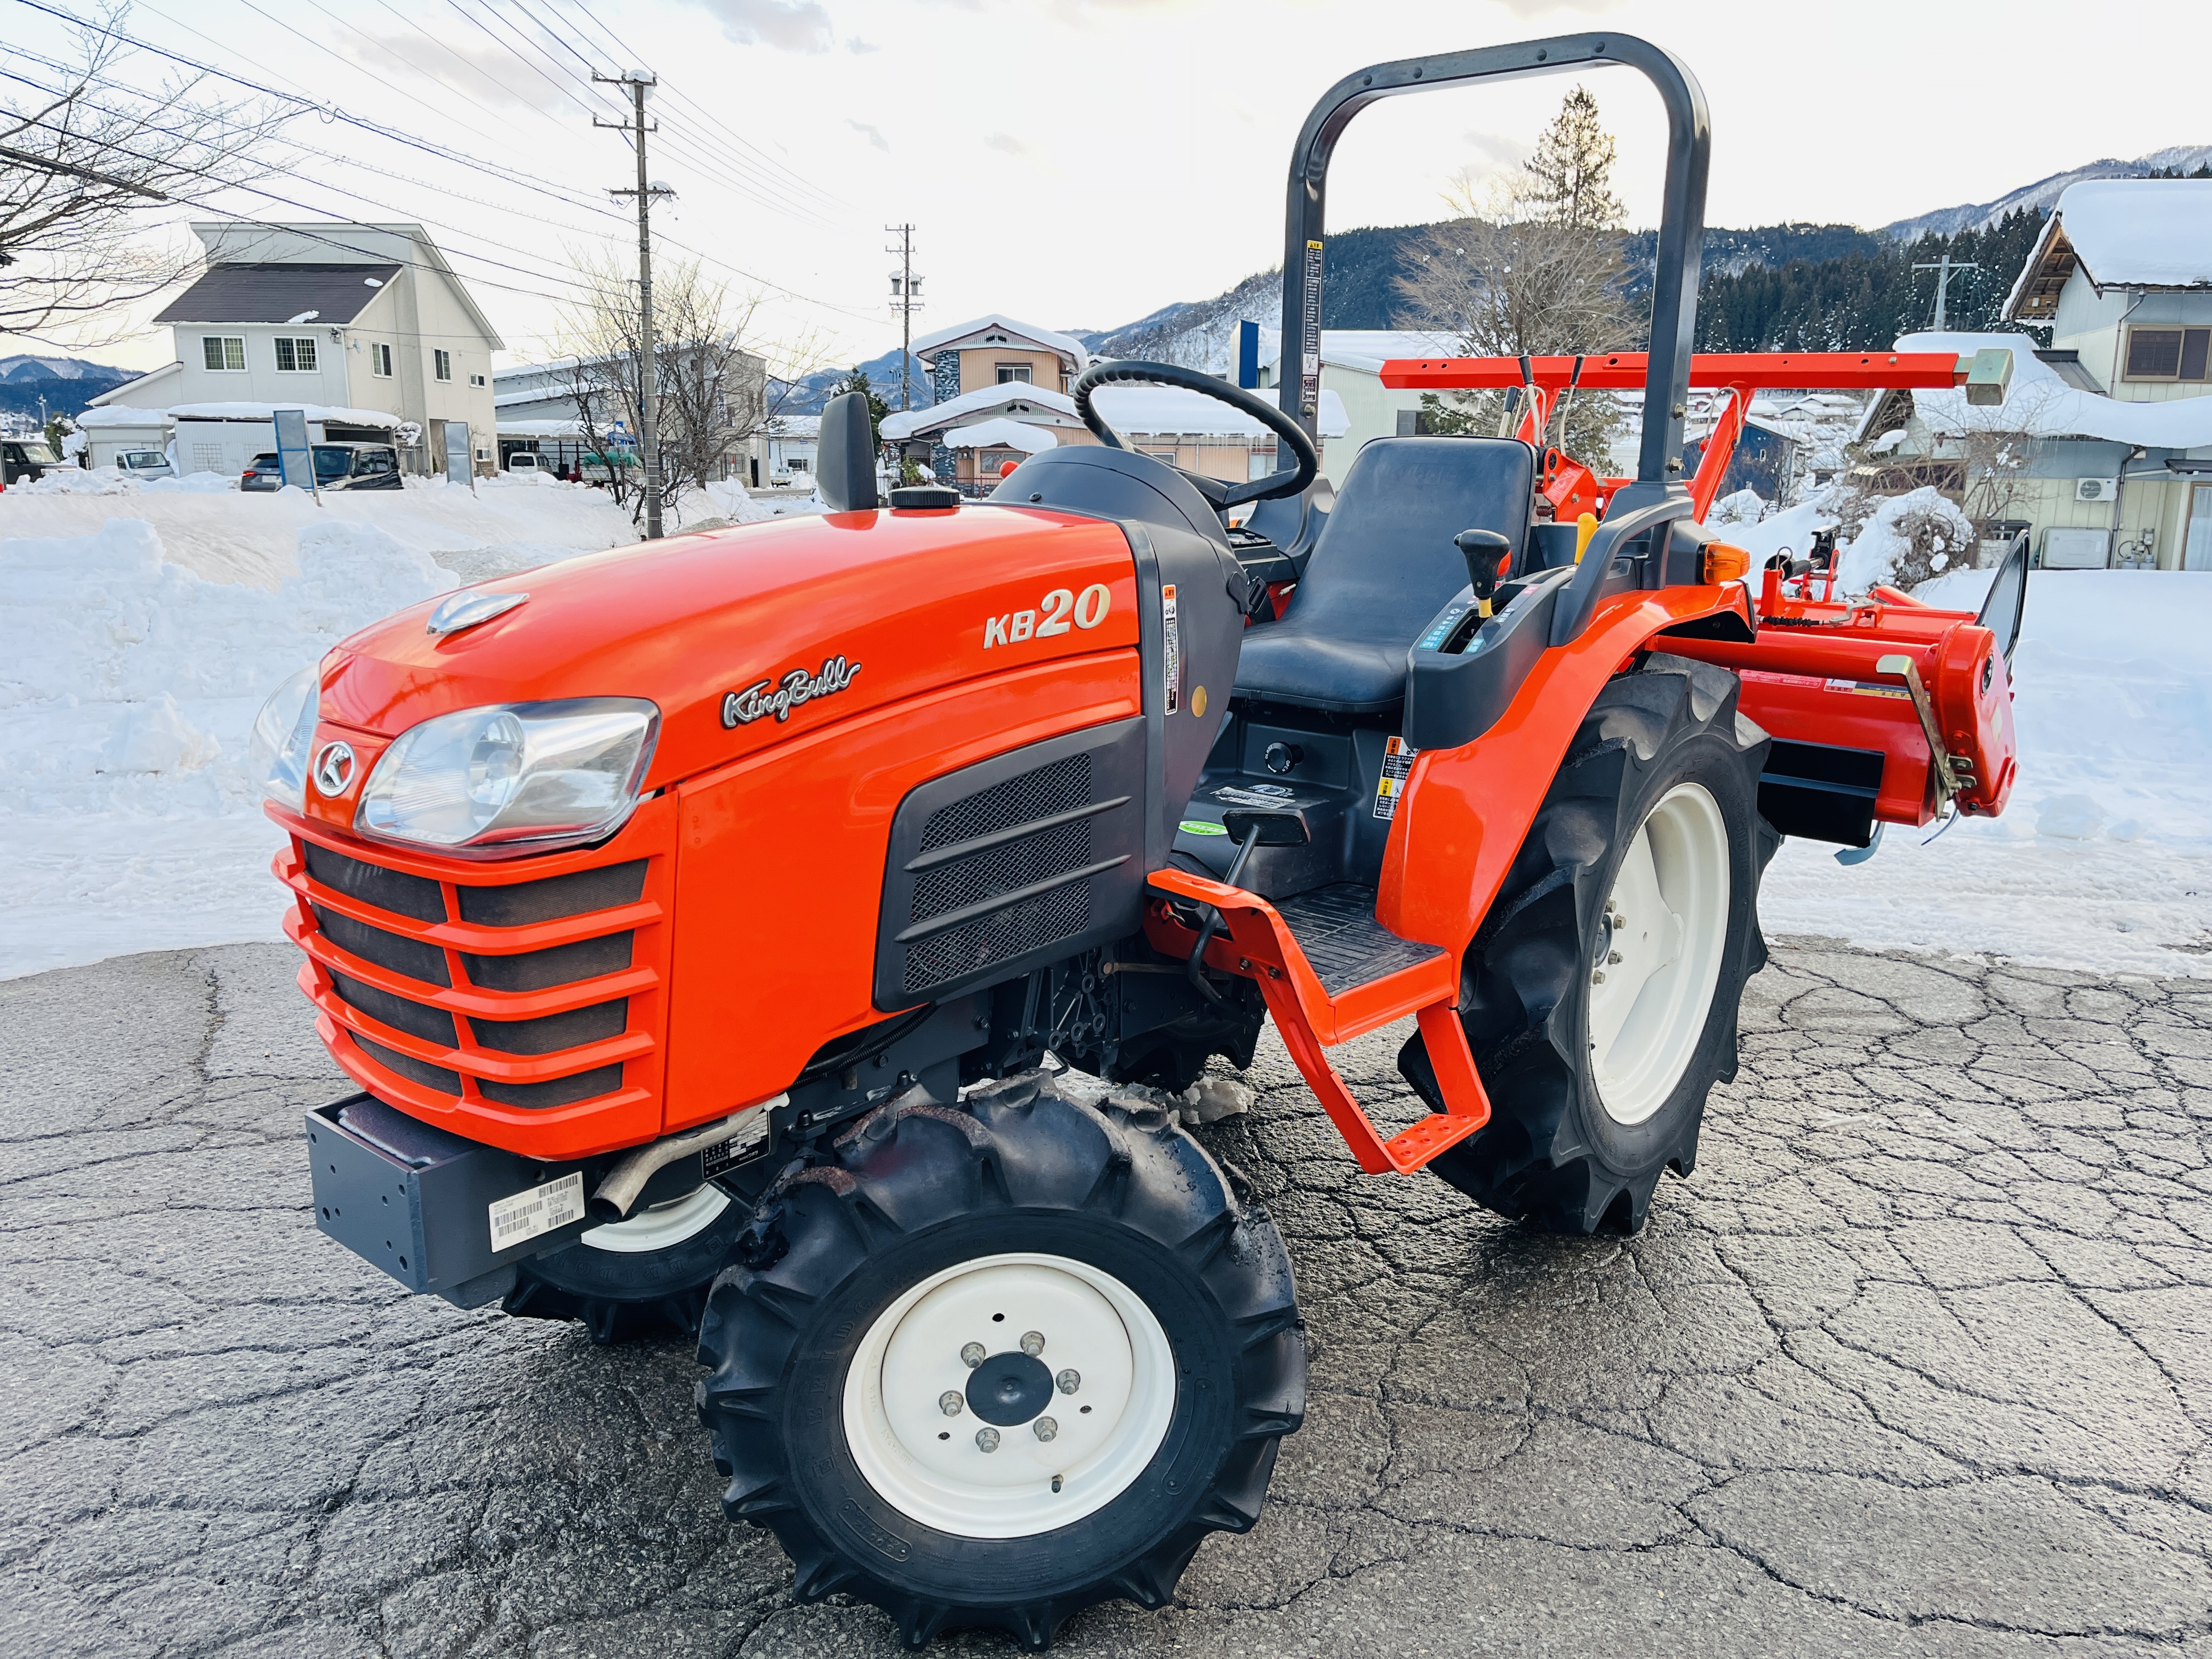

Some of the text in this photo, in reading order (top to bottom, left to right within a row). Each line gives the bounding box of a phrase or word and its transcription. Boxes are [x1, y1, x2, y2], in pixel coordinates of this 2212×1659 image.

[983, 584, 1110, 650] KB20
[721, 654, 861, 730] KingBull
[1282, 760, 1290, 772] OPEN
